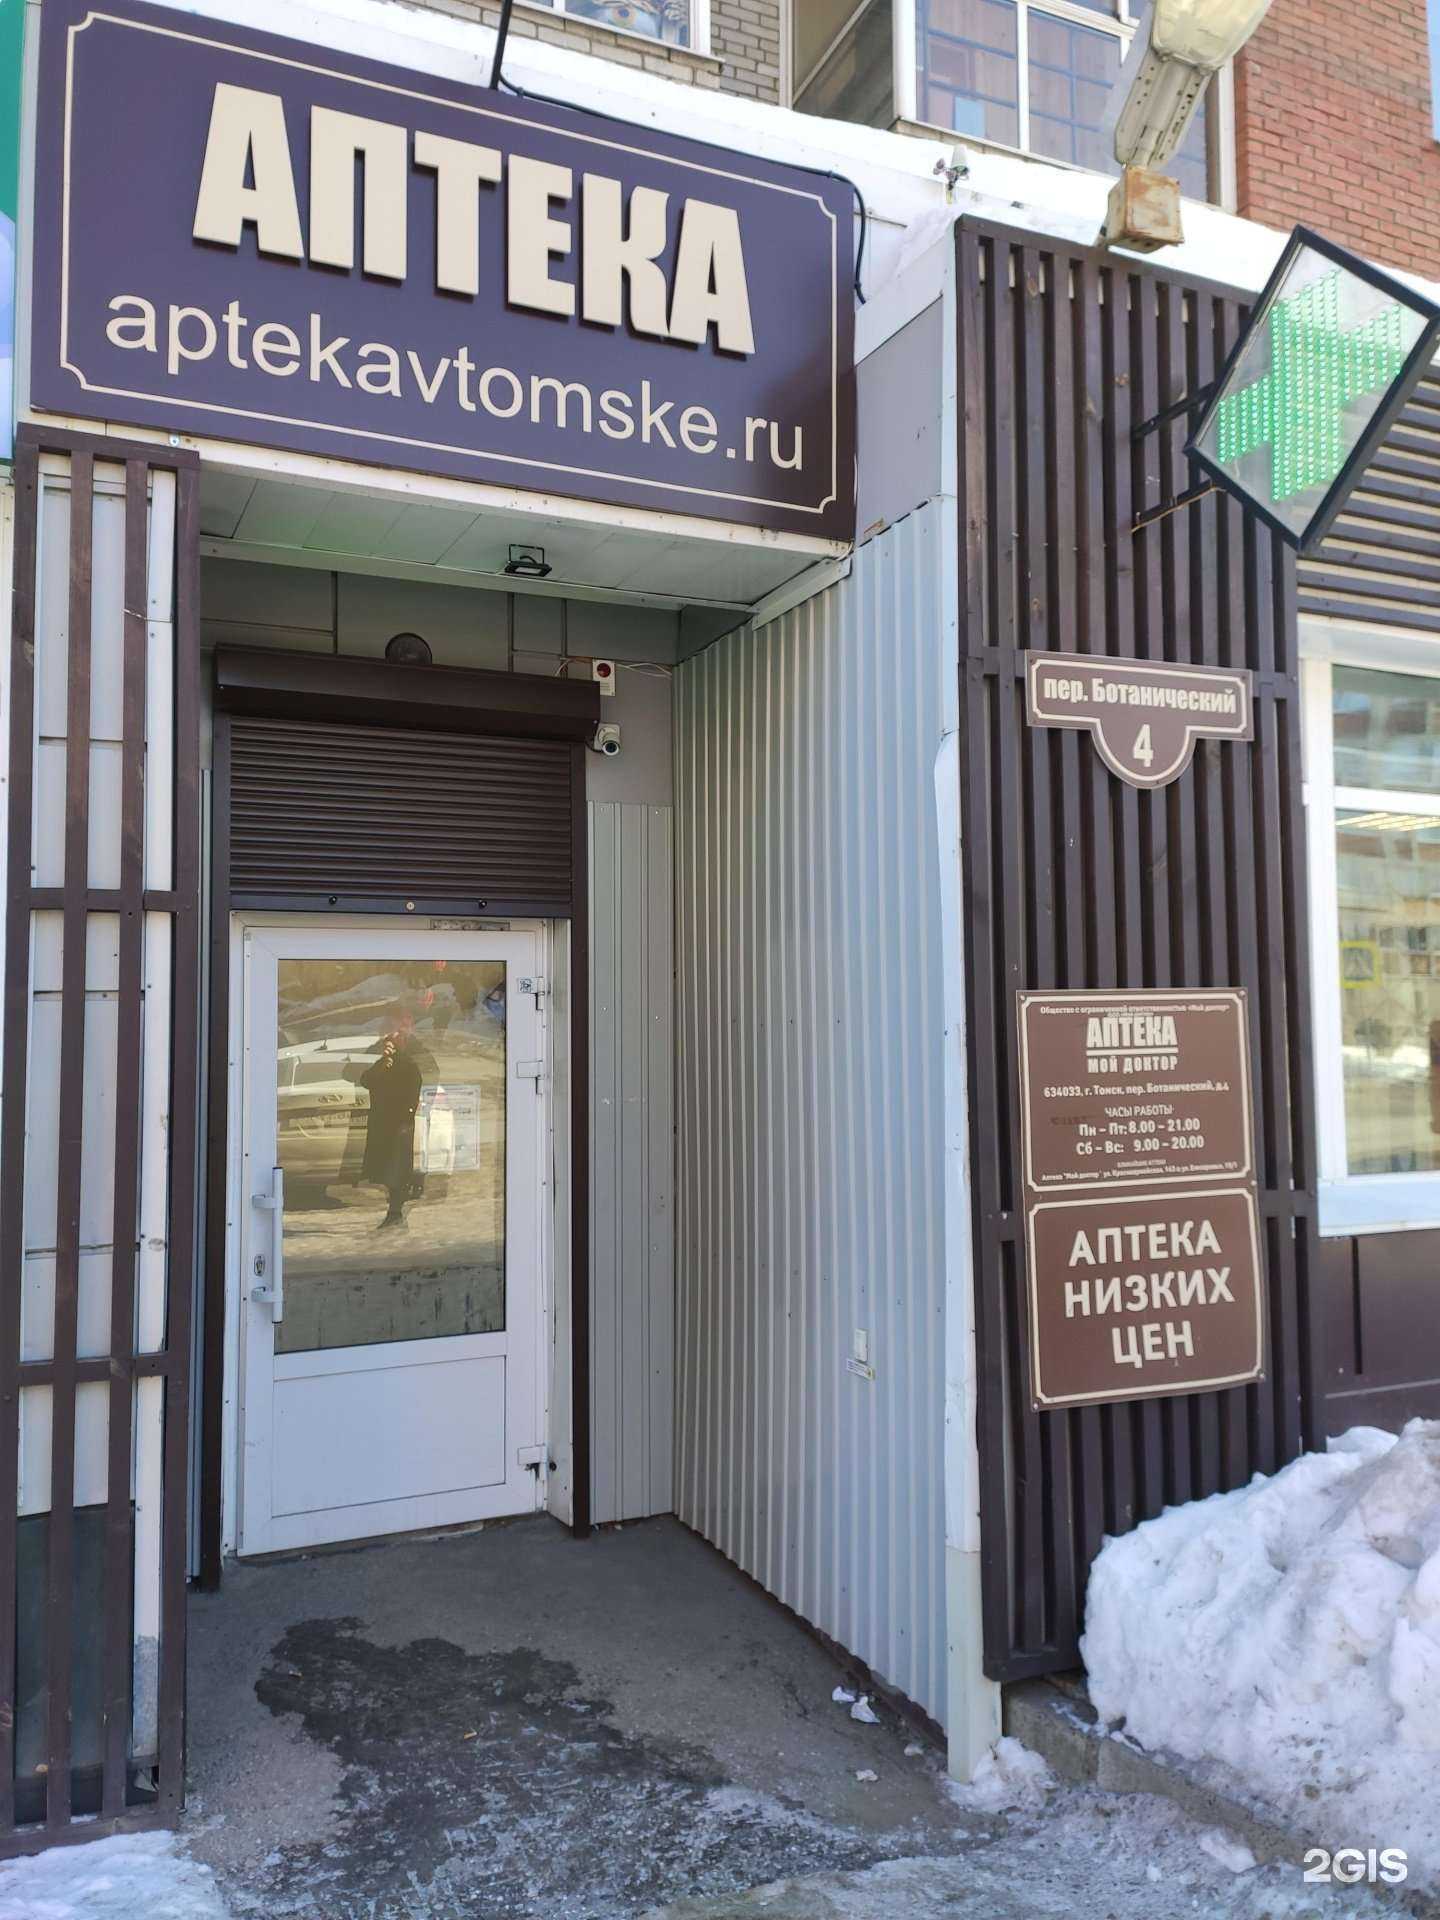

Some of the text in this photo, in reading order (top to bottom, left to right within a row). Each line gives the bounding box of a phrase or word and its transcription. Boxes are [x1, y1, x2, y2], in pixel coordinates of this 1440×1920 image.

[192, 82, 755, 356] АПТЕКА
[105, 294, 803, 470] aptekavtomske.ru
[1044, 678, 1237, 714] пер. Ботанический
[1133, 724, 1154, 767] 4
[1086, 1016, 1178, 1048] АПТЕКА
[1088, 1056, 1178, 1074] МОЙ ДОКТОР
[1079, 1123, 1096, 1137] Пн
[1128, 1120, 1156, 1134] 8.00
[1168, 1118, 1201, 1132] 21.00
[1104, 1106, 1133, 1118] ЧАСЫ
[1076, 1141, 1093, 1155] Сб
[1133, 1138, 1160, 1152] 9.00
[1172, 1135, 1205, 1150] 20.00
[1068, 1220, 1222, 1267] АПТЕКА
[1064, 1267, 1236, 1318] НИЗКИХ
[1111, 1320, 1195, 1369] ЦЕН
